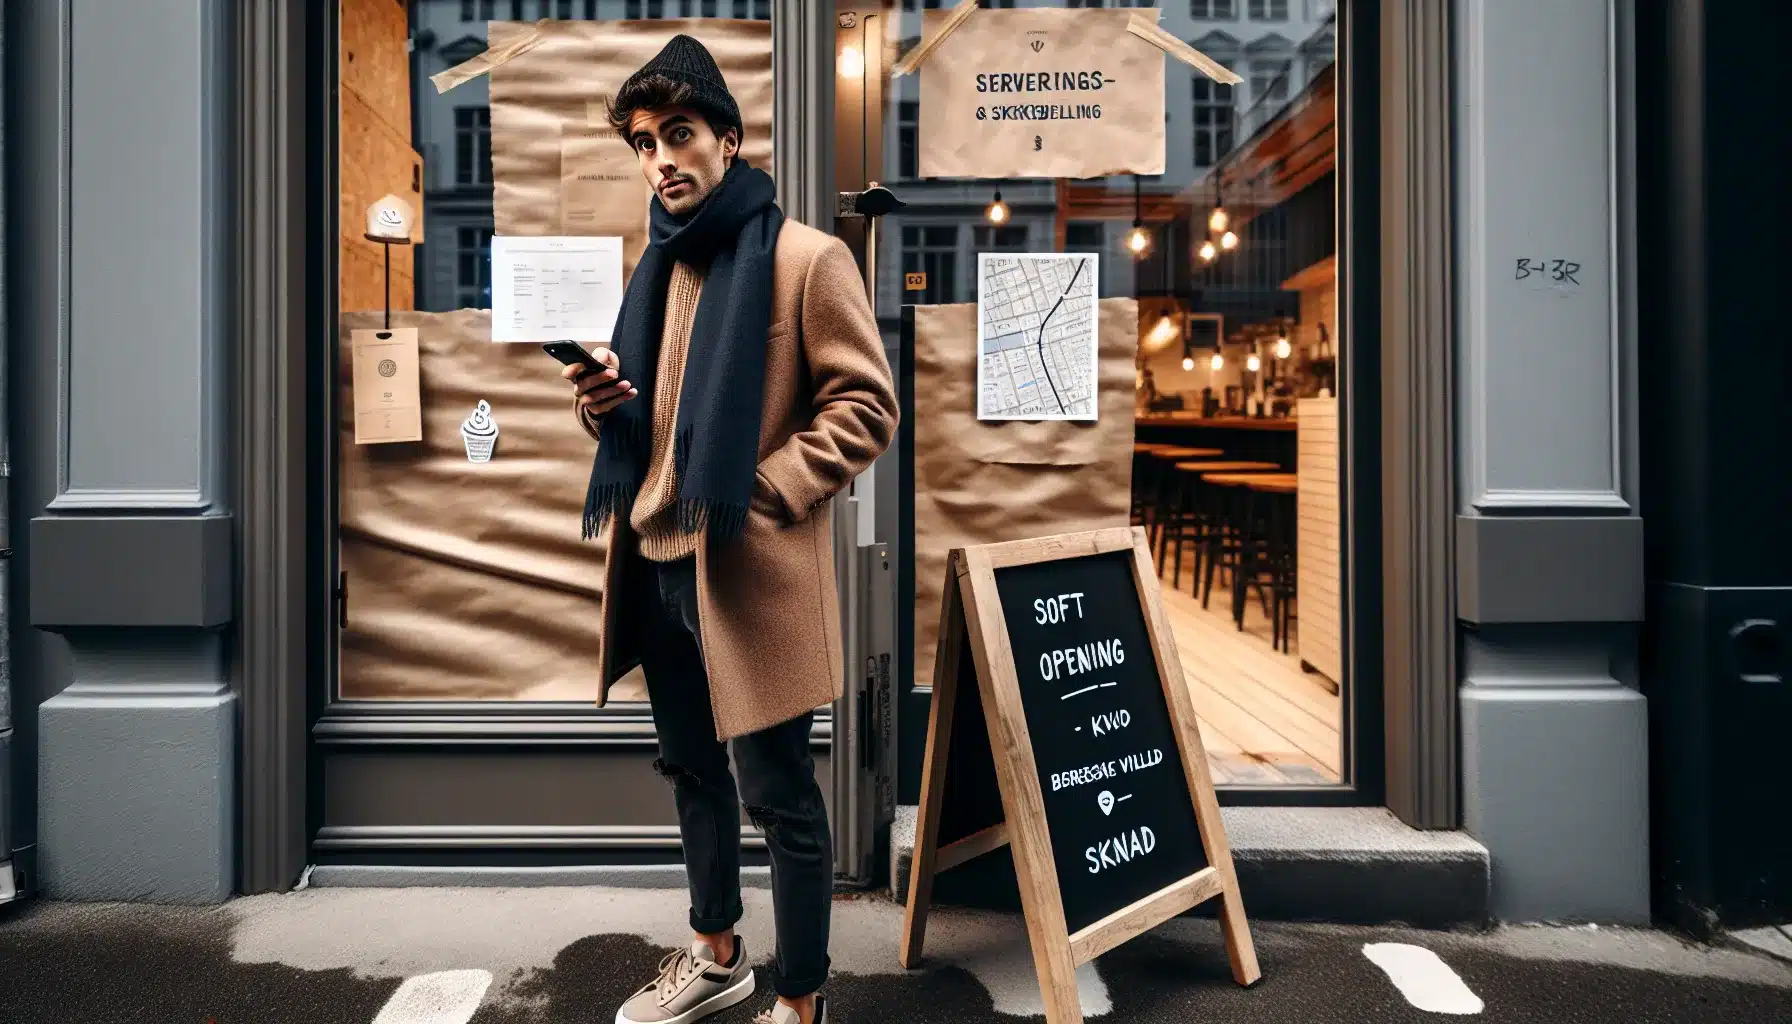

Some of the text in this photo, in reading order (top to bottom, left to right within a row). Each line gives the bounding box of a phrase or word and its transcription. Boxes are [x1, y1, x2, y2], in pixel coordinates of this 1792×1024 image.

[976, 71, 1116, 93] SERVERINGS-
[1034, 592, 1084, 625] SOFT
[1039, 638, 1125, 681] OPENING
[1085, 825, 1156, 874] SKNAD
